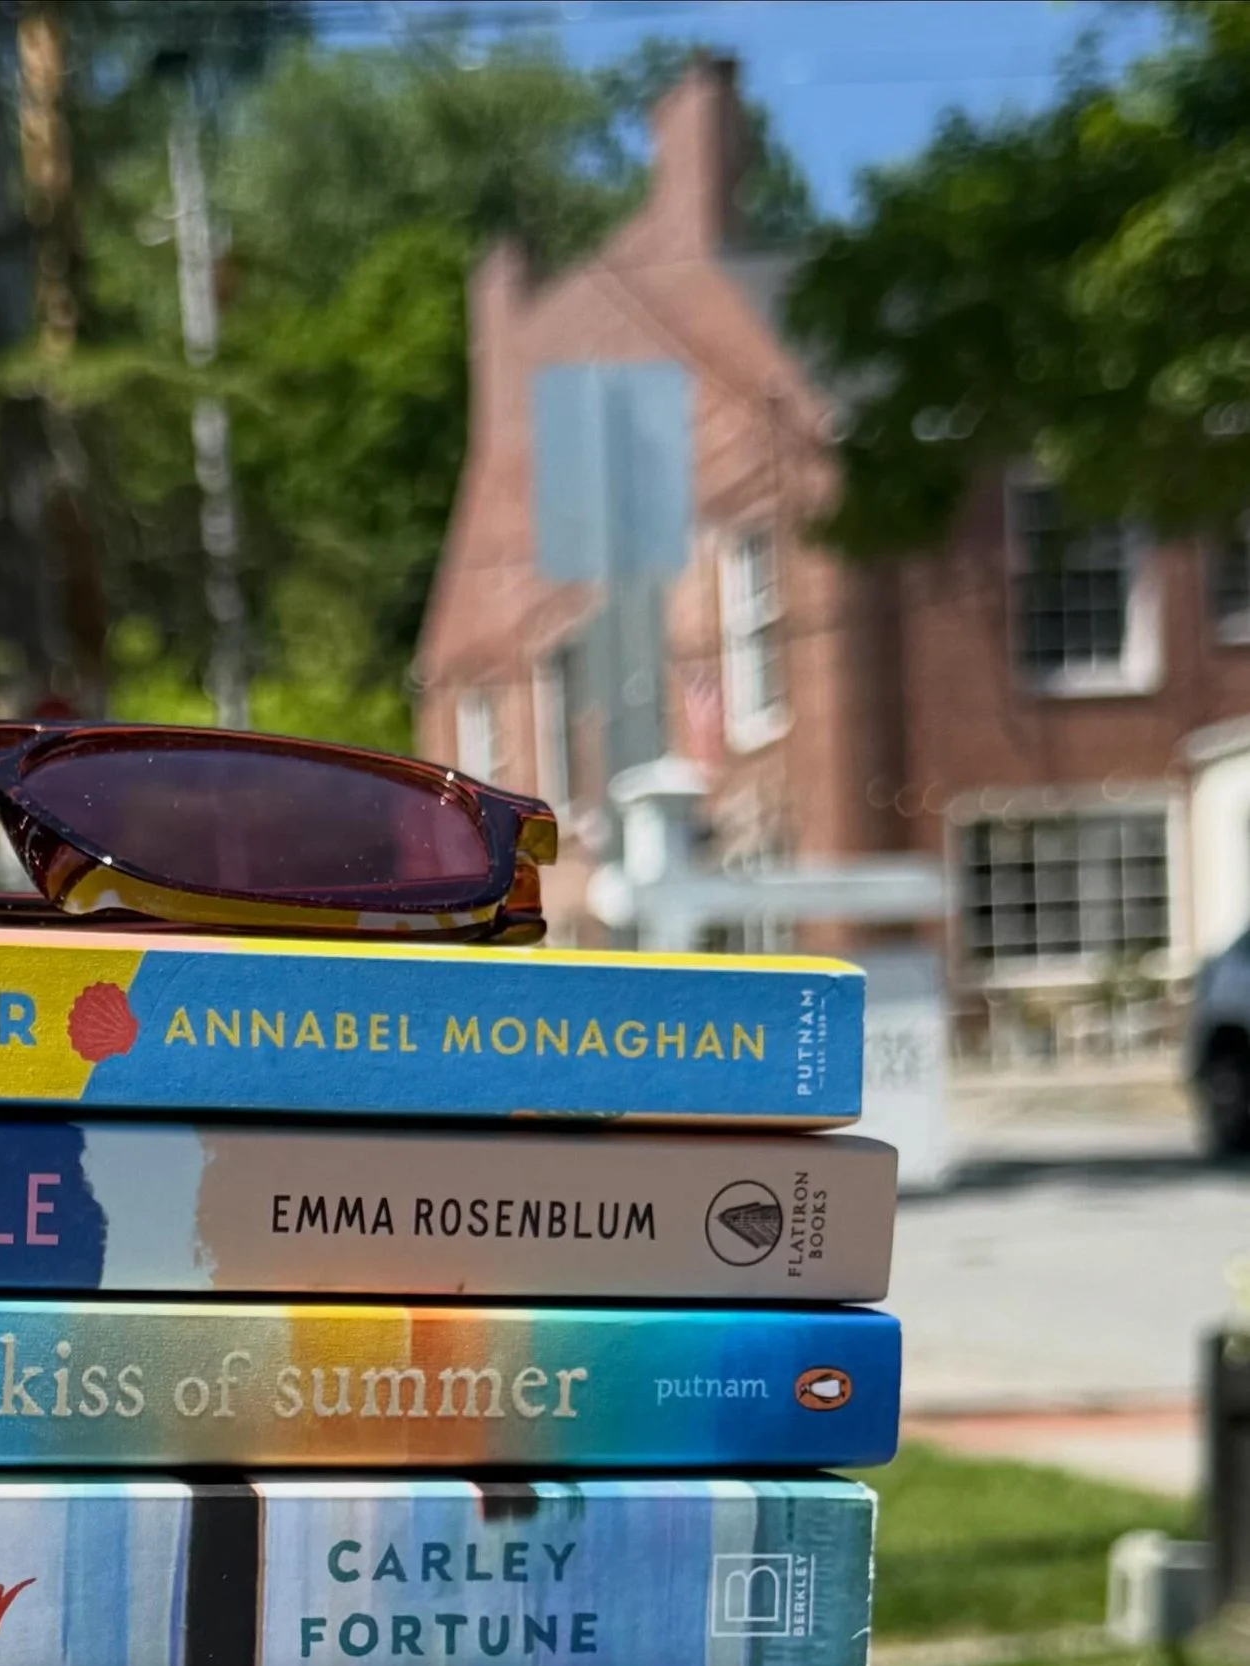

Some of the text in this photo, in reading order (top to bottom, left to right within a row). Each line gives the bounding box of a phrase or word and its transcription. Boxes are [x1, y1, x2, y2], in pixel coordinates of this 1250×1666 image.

[164, 1007, 765, 1061] ANNABEL MONAGHAN
[797, 988, 815, 1096] PUTNAM
[272, 1194, 656, 1240] EMMA ROSENBLUM
[788, 1171, 809, 1277] FLATIRON
[809, 1190, 827, 1258] BOOKS
[174, 1349, 251, 1419] of
[273, 1365, 588, 1420] summer
[654, 1374, 770, 1404] putnam
[327, 1539, 576, 1583] CARLEY
[792, 1554, 808, 1637] BERKLEY
[301, 1612, 598, 1658] FORTUNE
